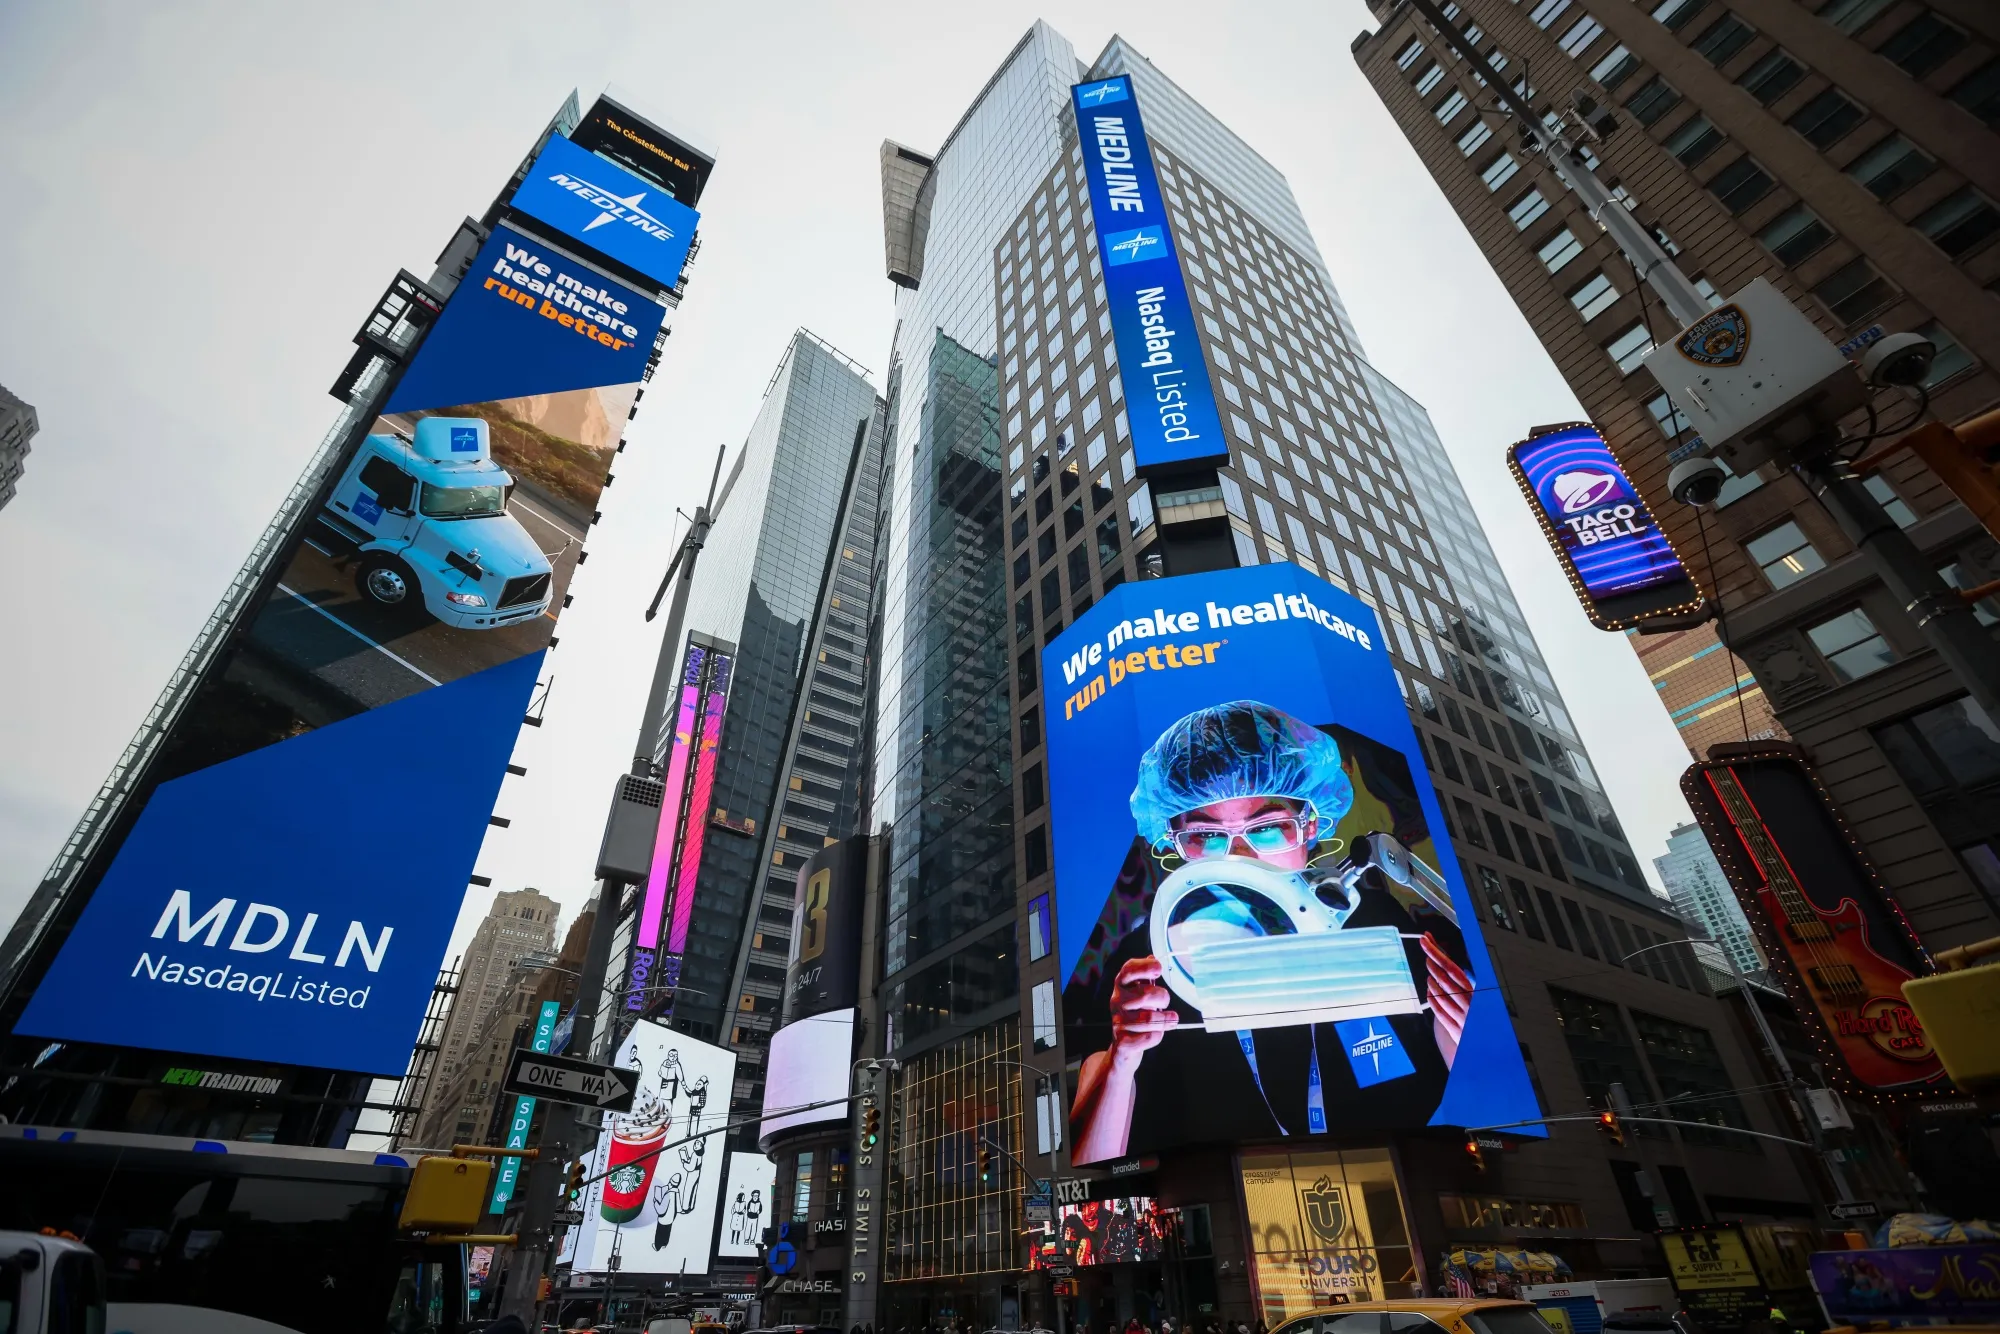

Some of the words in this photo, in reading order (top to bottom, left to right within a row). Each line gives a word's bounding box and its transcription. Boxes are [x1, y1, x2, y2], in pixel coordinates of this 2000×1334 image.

[1084, 86, 1121, 98] MEDLINE
[606, 118, 622, 133] The
[622, 129, 673, 162] Constellation
[674, 158, 690, 172] Ball
[1094, 116, 1144, 212] MEDLINE
[548, 174, 674, 242] MEDLINE
[1112, 238, 1158, 252] MEDLINE
[483, 276, 535, 310] run
[505, 244, 552, 278] We
[556, 272, 628, 316] make
[493, 258, 638, 340] healthcare
[1683, 312, 1737, 352] DEPARTMENT
[1688, 312, 1720, 338] POLICE
[1840, 326, 1882, 356] NYPD
[1692, 353, 1709, 363] CITY
[1564, 504, 1636, 533] TACO
[1576, 518, 1647, 547] BELL
[1062, 640, 1102, 685] We
[1106, 608, 1200, 652] make
[1206, 593, 1372, 651] healthcare
[1064, 673, 1106, 721] run
[150, 889, 394, 972] MDLN
[801, 868, 831, 964] 3
[798, 966, 822, 990] 24/7
[1834, 1009, 1892, 1035] Hard
[1892, 1006, 1922, 1034] Ro
[1352, 1036, 1394, 1058] MEDLINE
[528, 1066, 566, 1089] ONE
[581, 1076, 618, 1097] WAY
[1477, 1137, 1503, 1149] branded
[1112, 1160, 1140, 1174] branded
[854, 1188, 871, 1255] TIMES
[1836, 1206, 1849, 1215] ONE
[815, 1220, 846, 1232] CHAS
[853, 1271, 866, 1282] 3
[1294, 1254, 1377, 1276] TOURO
[1692, 1262, 1722, 1272] SUPPLY
[783, 1280, 832, 1292] CHASE
[1300, 1276, 1376, 1289] UNIVERSITY
